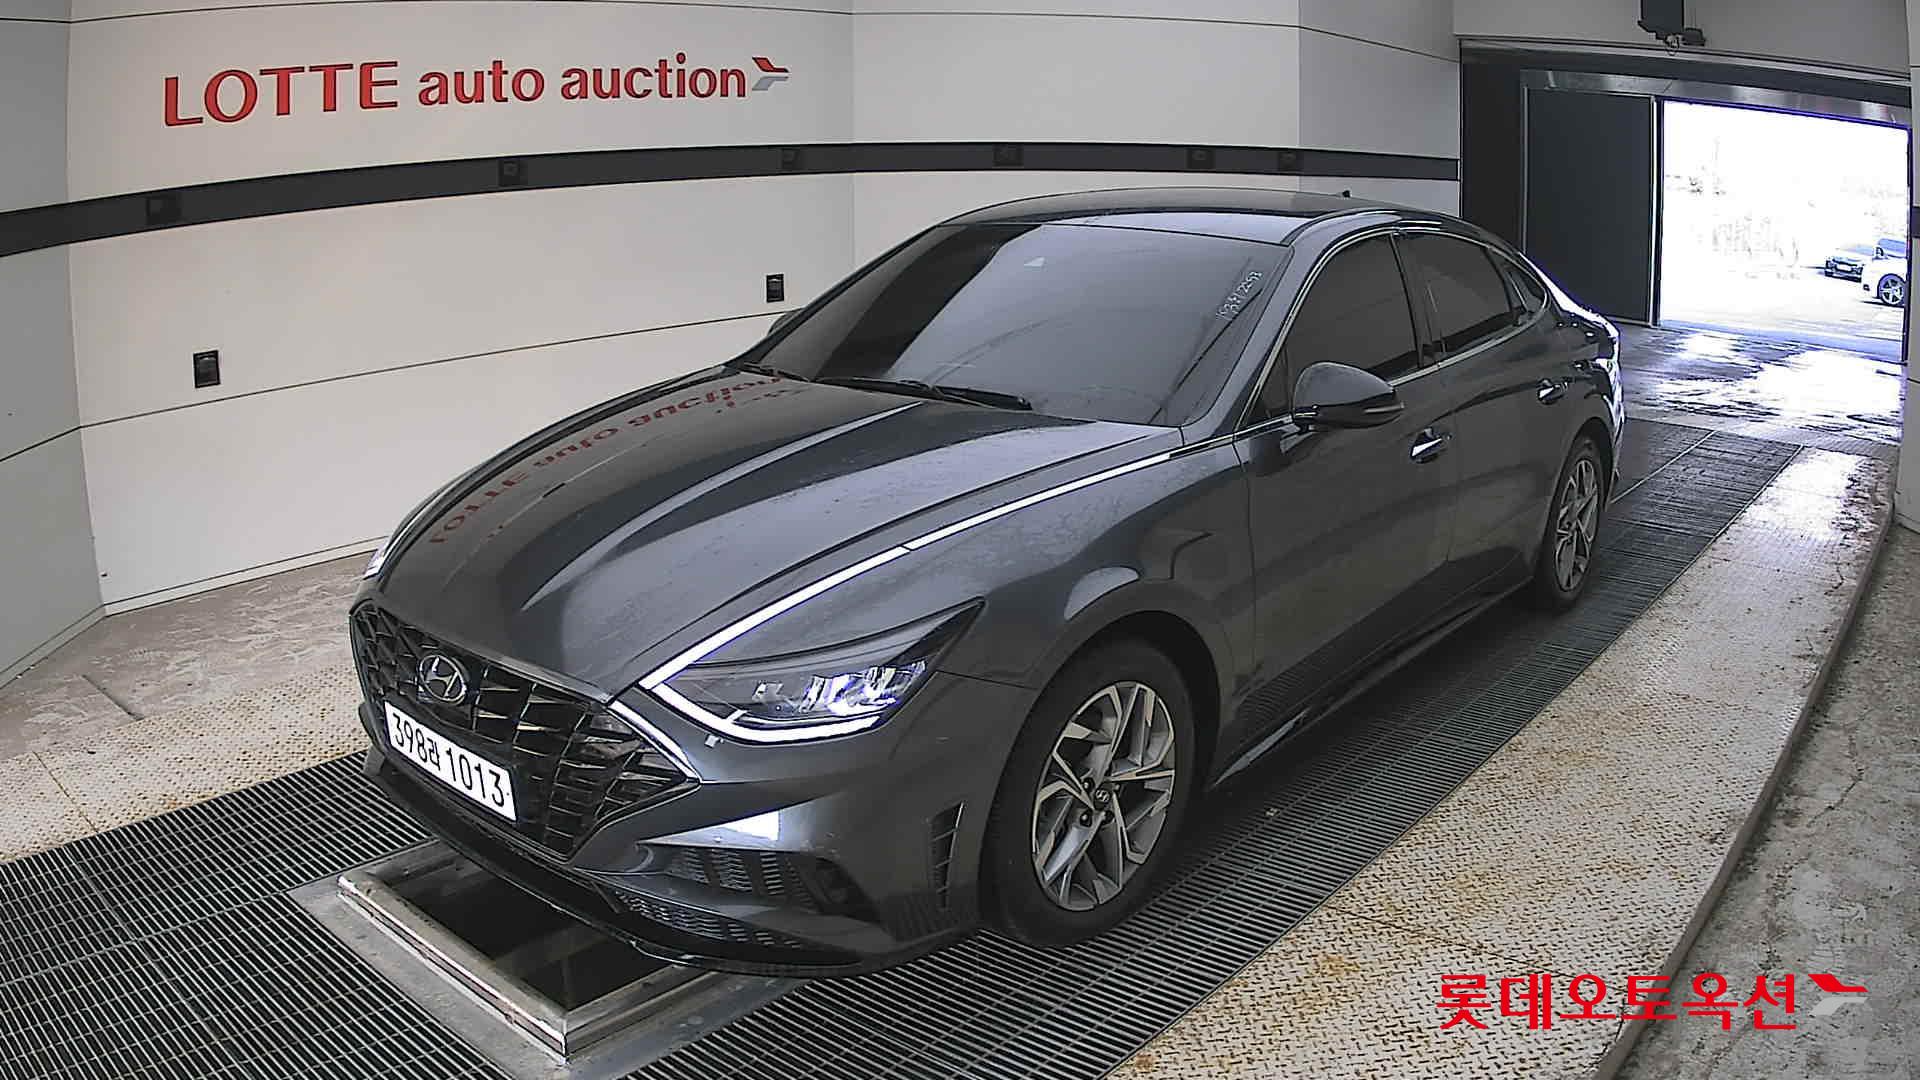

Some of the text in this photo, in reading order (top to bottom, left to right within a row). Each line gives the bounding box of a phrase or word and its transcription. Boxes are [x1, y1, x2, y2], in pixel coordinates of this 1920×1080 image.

[164, 53, 747, 127] LOTTE auto auction
